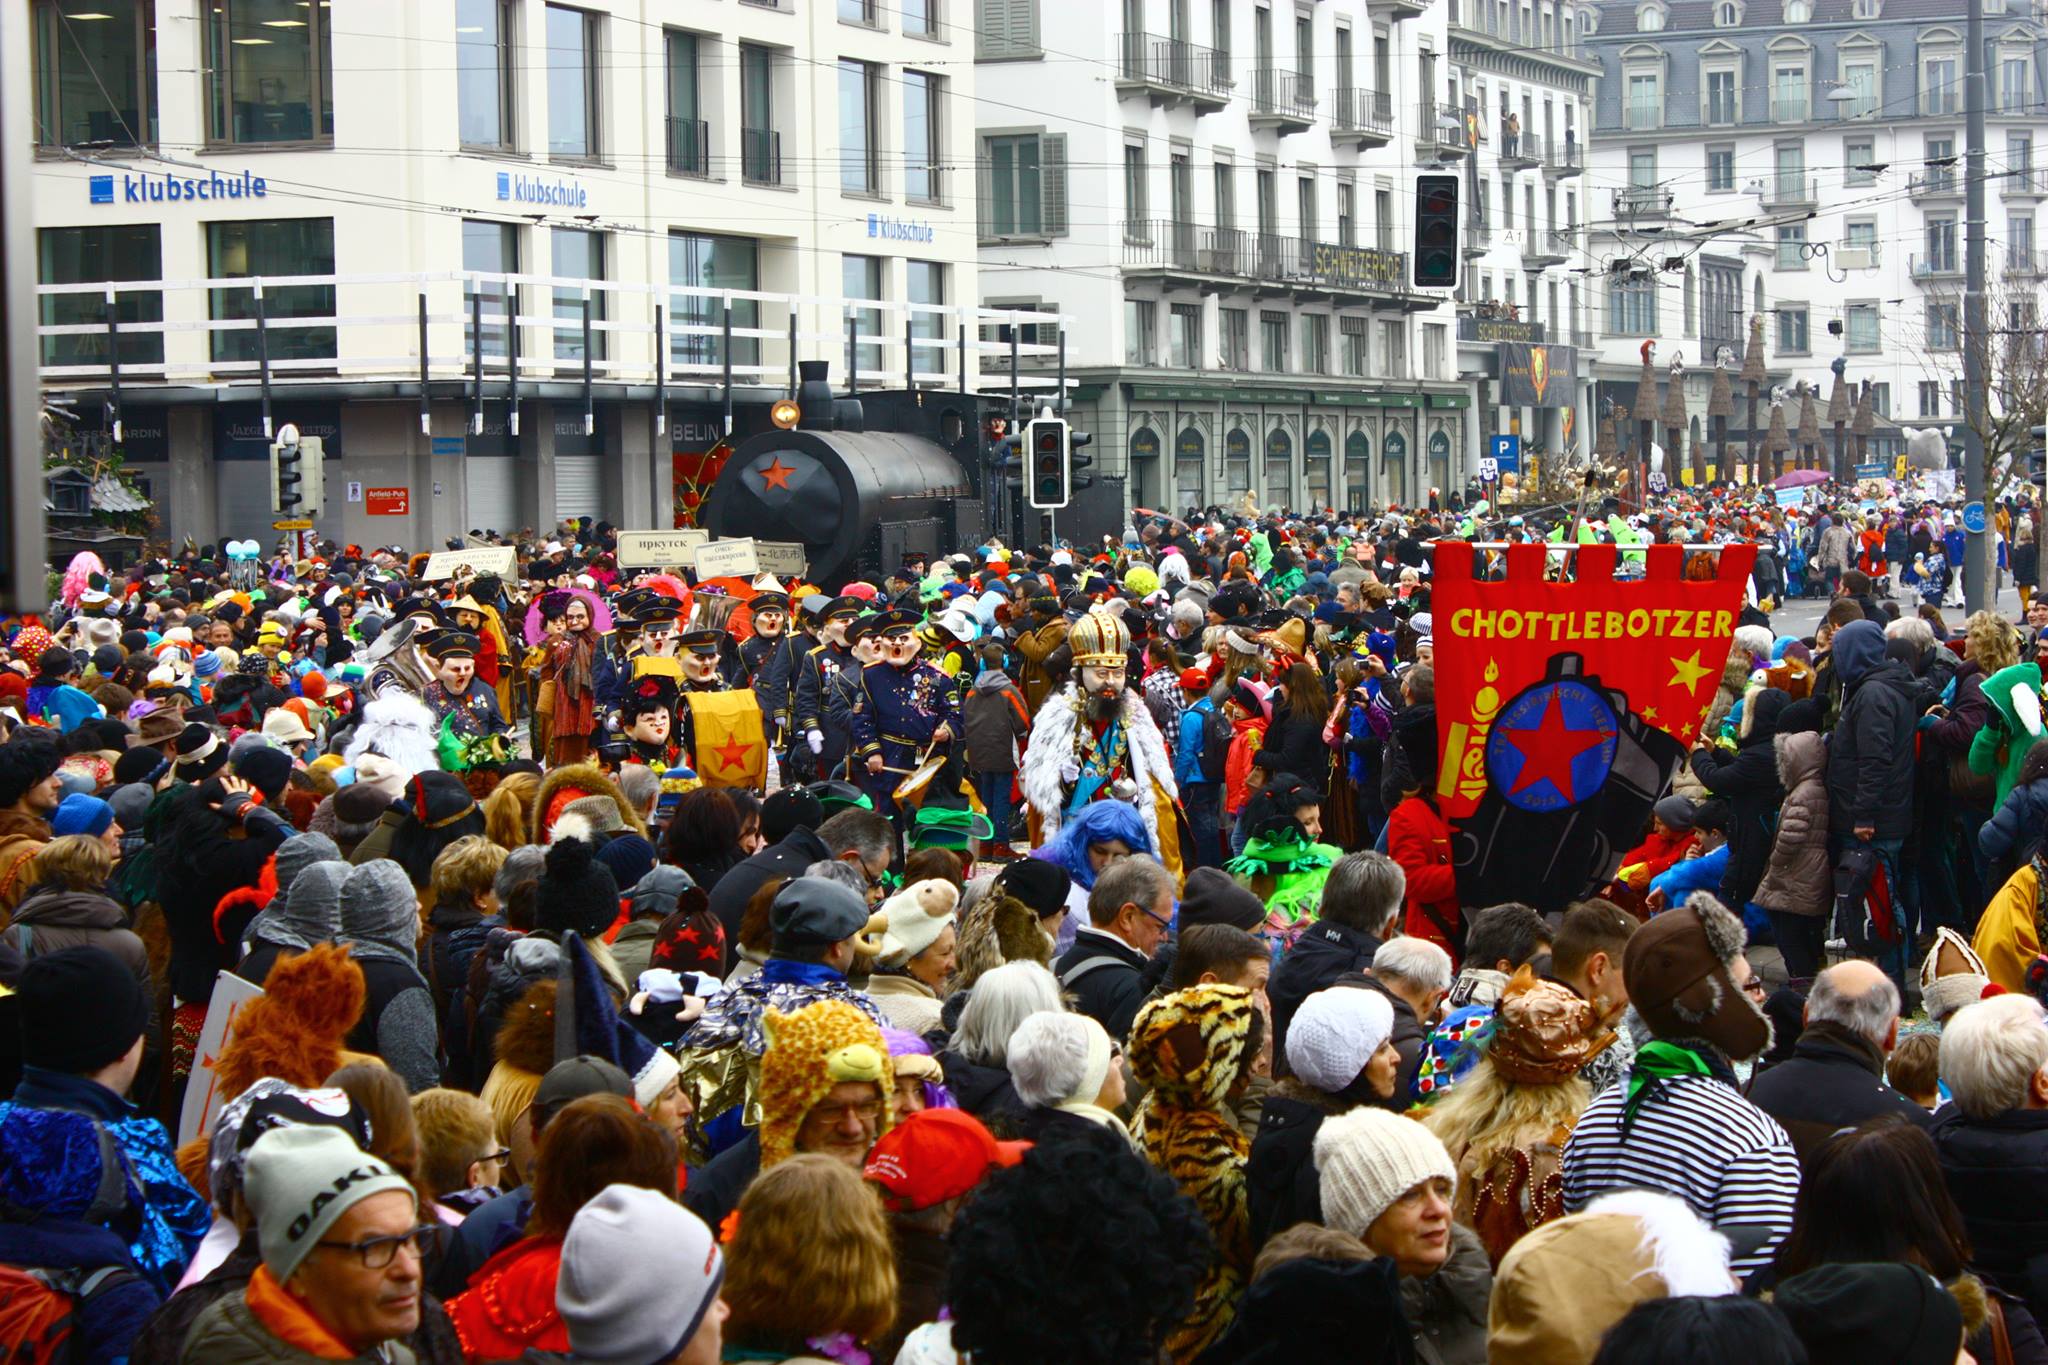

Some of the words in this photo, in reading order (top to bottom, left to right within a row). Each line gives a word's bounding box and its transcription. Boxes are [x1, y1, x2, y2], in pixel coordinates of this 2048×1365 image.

[125, 170, 267, 203] klubschule
[515, 174, 587, 208] klubschule
[881, 216, 933, 243] klubschule
[1504, 231, 1521, 242] A1
[1315, 246, 1401, 282] SCHWEIZERHOF
[122, 428, 161, 440] ARDIN
[1499, 441, 1510, 454] P
[1451, 608, 1733, 641] CHOTTLEBOTZER
